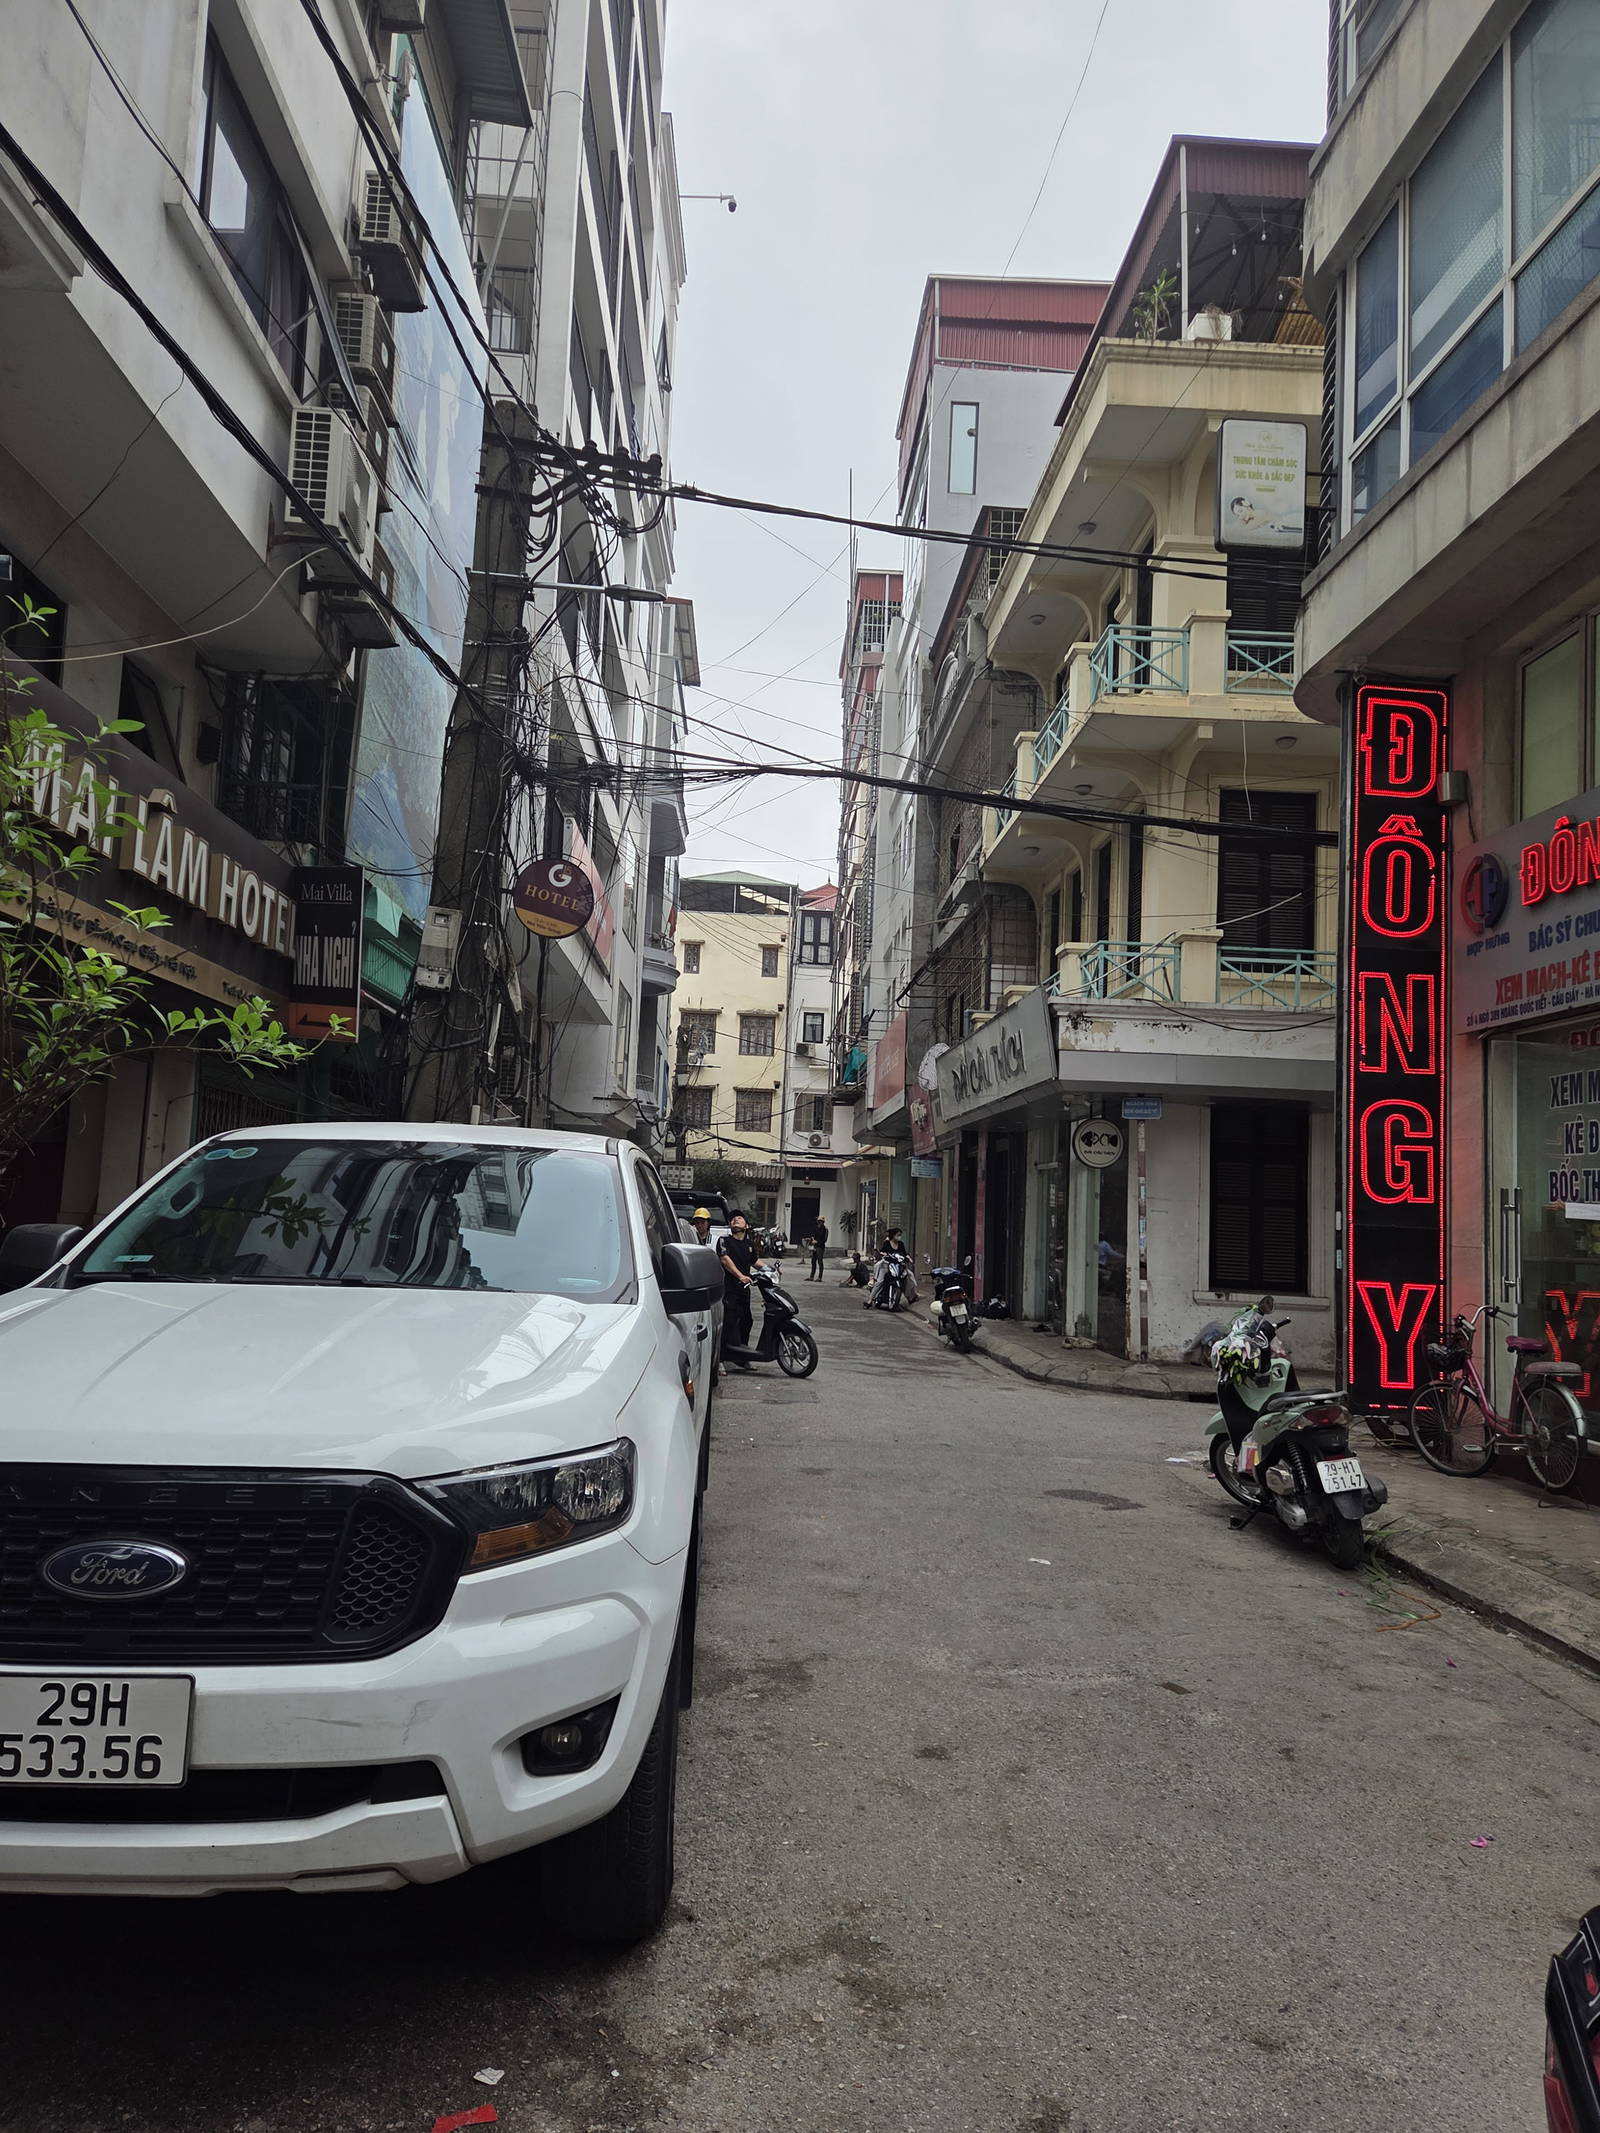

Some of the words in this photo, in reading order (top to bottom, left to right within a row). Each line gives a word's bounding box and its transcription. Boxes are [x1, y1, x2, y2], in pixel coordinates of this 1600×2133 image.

[131, 791, 209, 912] LÂM
[218, 854, 296, 960] HOTEL
[301, 883, 324, 900] Mai
[326, 883, 352, 902] Villa
[525, 884, 578, 911] HOTEL
[293, 924, 319, 987] NHÀ
[322, 921, 357, 989] NGHỈ
[1360, 697, 1436, 1205] ĐÔNG
[1528, 924, 1553, 953] BÁC
[1556, 915, 1571, 945] SỸ
[1495, 971, 1523, 1006] XEM
[1550, 1071, 1584, 1109] XEM
[1564, 1113, 1585, 1156] KÊ
[1549, 1156, 1580, 1203] BỐC
[1356, 1281, 1436, 1390] Y
[69, 1548, 151, 1587] Ford
[36, 1682, 130, 1728] 29H
[0, 1734, 163, 1780] 533.56
